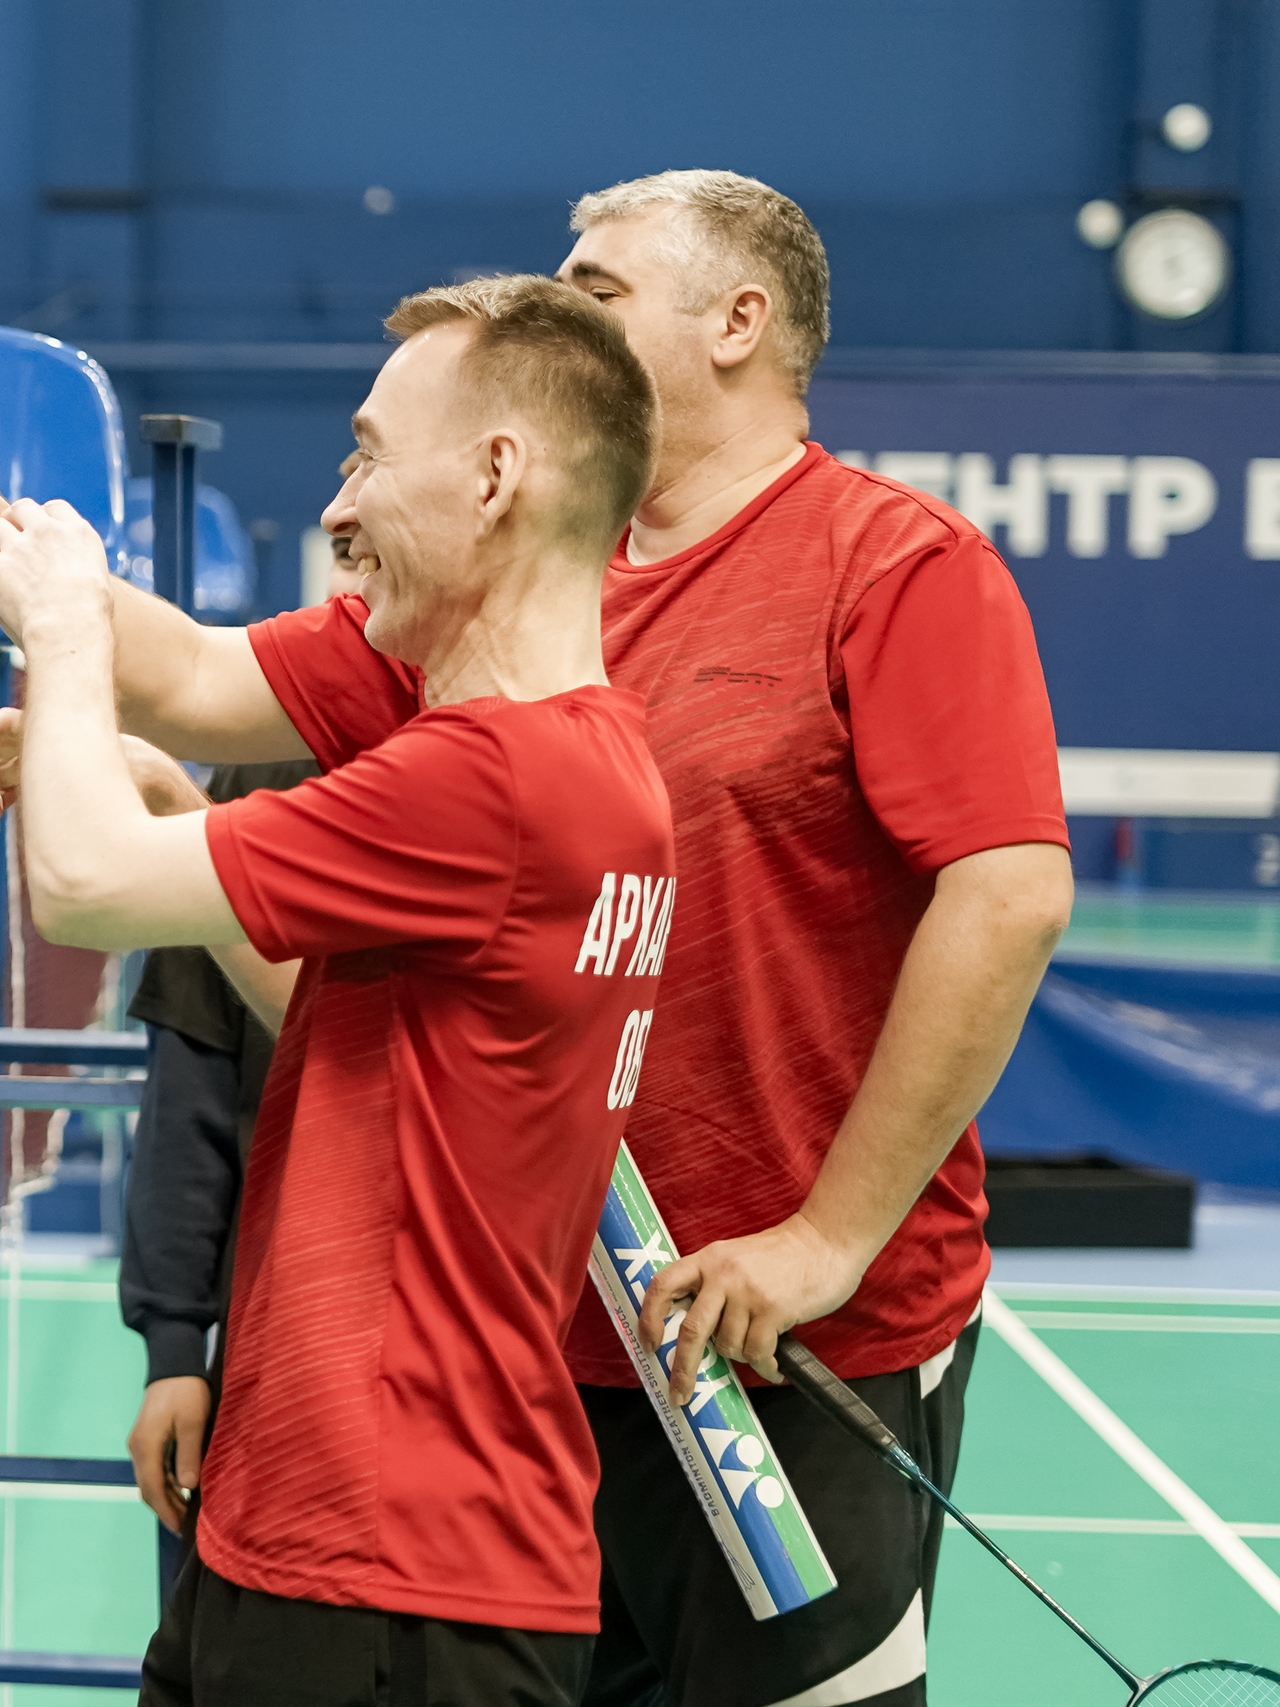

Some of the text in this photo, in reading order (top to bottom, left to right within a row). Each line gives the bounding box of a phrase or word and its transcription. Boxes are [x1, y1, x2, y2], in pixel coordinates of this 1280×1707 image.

[832, 450, 1218, 560] НТР
[614, 1304, 659, 1389] SHUTTLECOCK
[655, 1388, 686, 1445] FEATHER
[681, 1445, 719, 1517] BADMINTON
